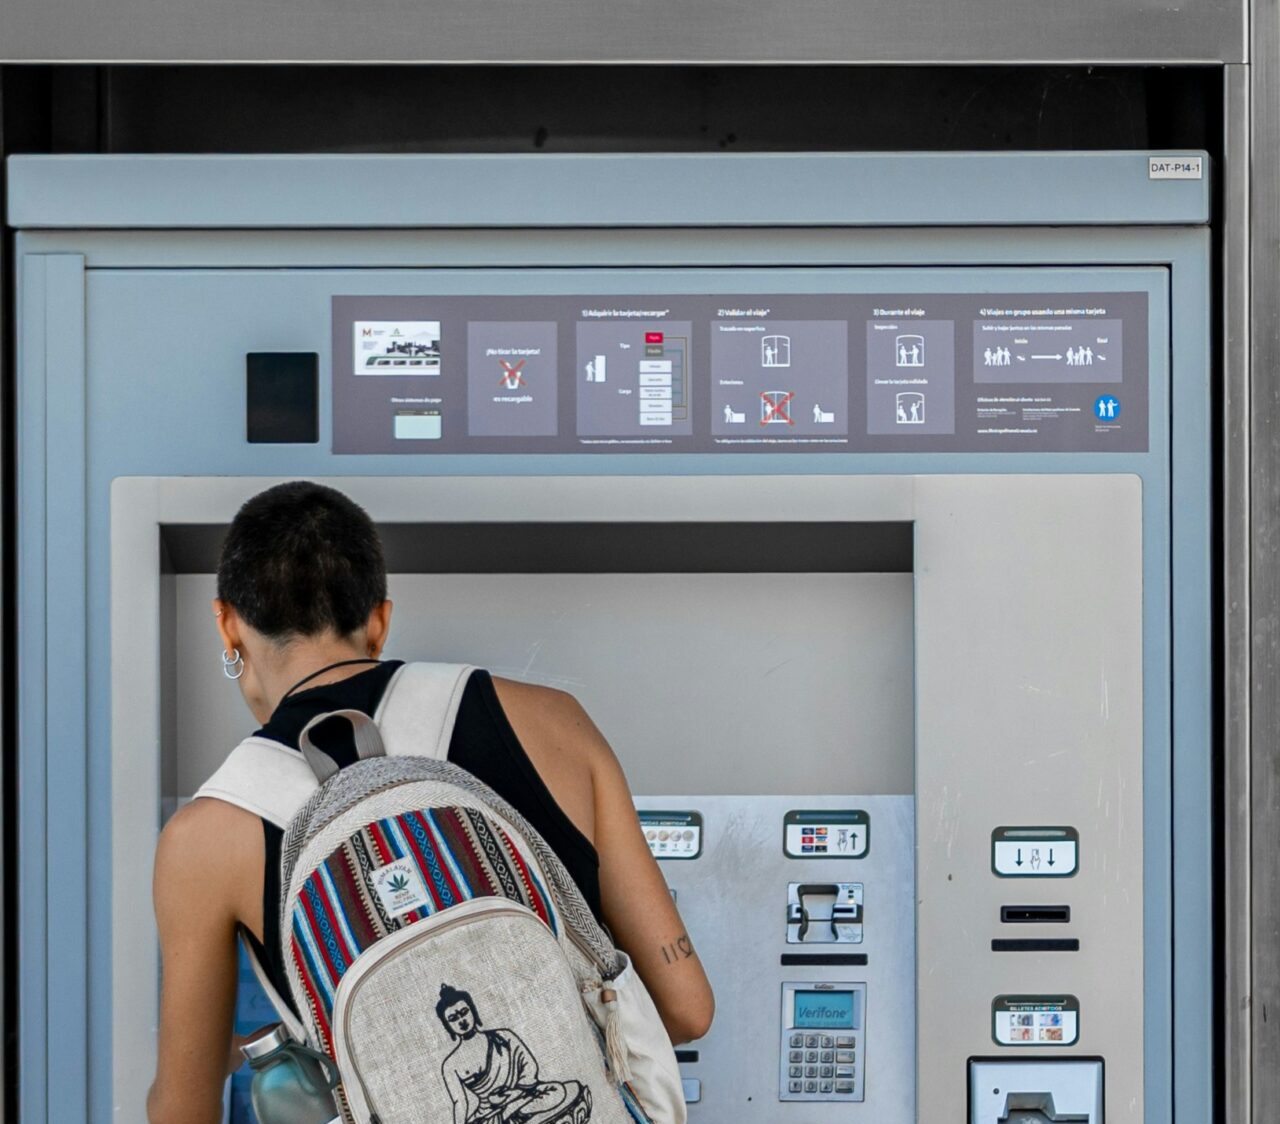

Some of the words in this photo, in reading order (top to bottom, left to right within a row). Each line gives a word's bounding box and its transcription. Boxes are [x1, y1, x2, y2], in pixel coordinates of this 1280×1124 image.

[1151, 163, 1200, 172] DAT-P14-1
[880, 308, 903, 316] Durante
[911, 308, 925, 316] viaje
[1014, 308, 1031, 316] grupo
[1066, 308, 1084, 316] misma
[1086, 308, 1106, 316] tarjeta
[799, 1006, 848, 1019] Verifone
